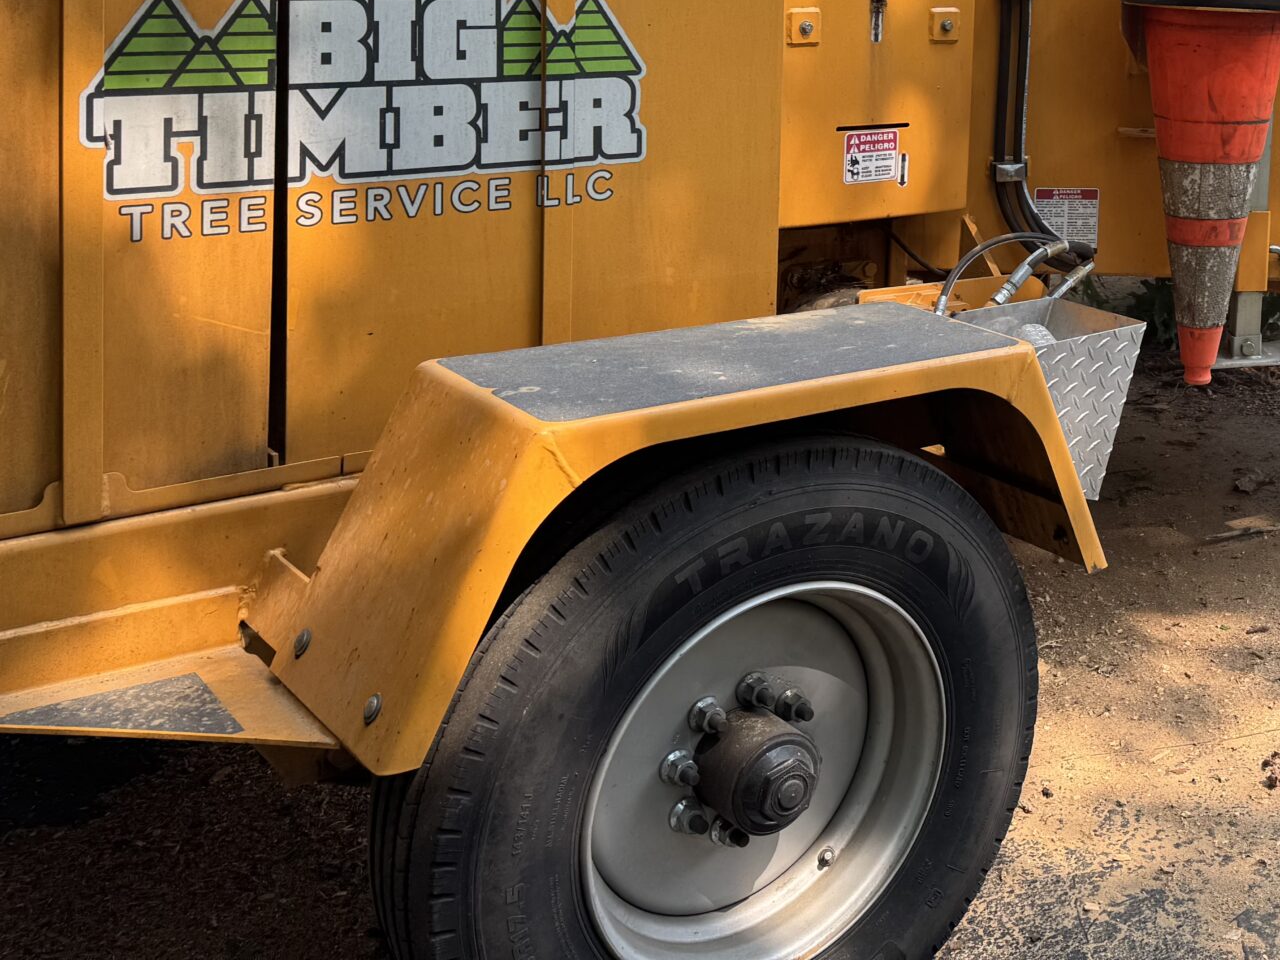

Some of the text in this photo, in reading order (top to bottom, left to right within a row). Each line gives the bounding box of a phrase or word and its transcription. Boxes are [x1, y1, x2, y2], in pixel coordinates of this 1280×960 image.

[86, 76, 641, 191] TIMBER
[860, 133, 894, 142] DANGER
[860, 142, 895, 151] PELIGRO
[119, 169, 614, 242] TREE SERVICE LLC
[674, 511, 934, 593] TRAZANO
